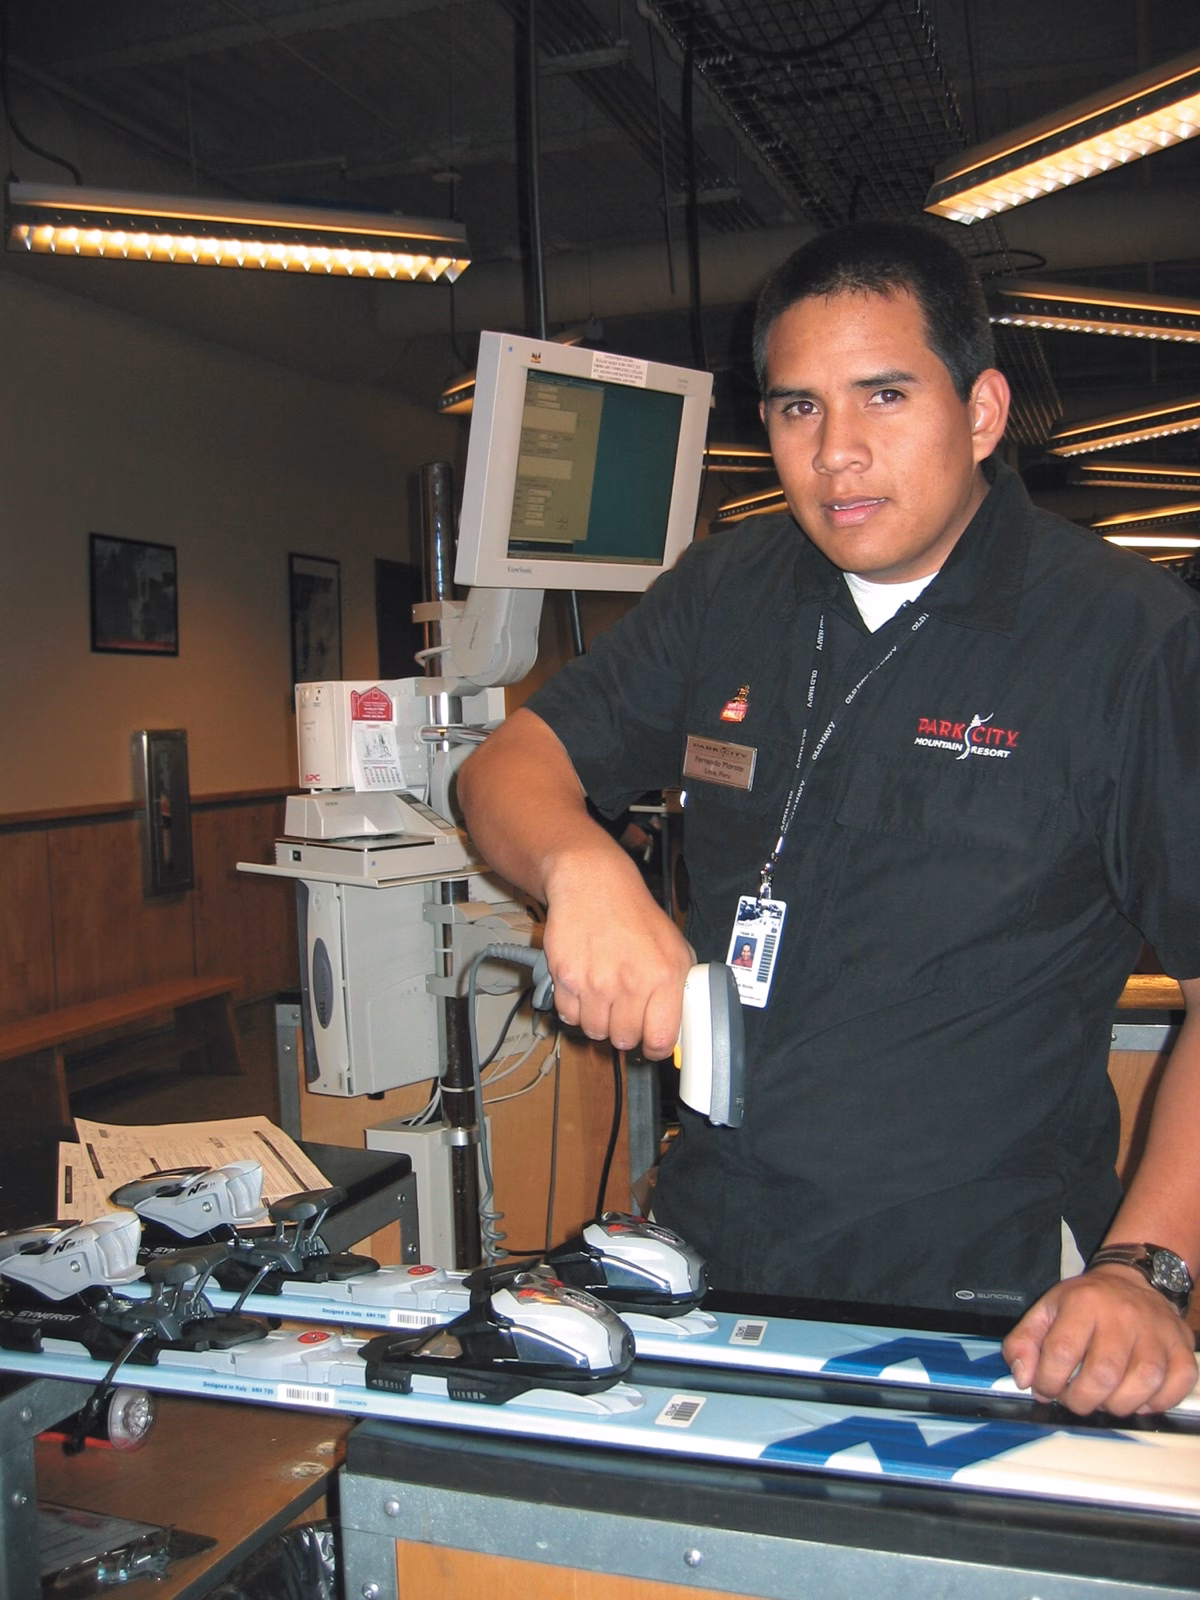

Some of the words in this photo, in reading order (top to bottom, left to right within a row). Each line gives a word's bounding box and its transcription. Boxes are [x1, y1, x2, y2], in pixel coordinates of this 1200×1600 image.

[810, 669, 818, 685] OLD
[812, 743, 824, 760] OLD
[820, 721, 836, 745] NAVY
[918, 718, 965, 740] PARK
[972, 726, 1019, 748] CITY
[914, 737, 963, 752] MOUNTAIN
[970, 746, 1011, 758] RESORT
[305, 774, 321, 782] APC
[17, 1310, 81, 1322] SYNERGY
[203, 1381, 227, 1390] Designed
